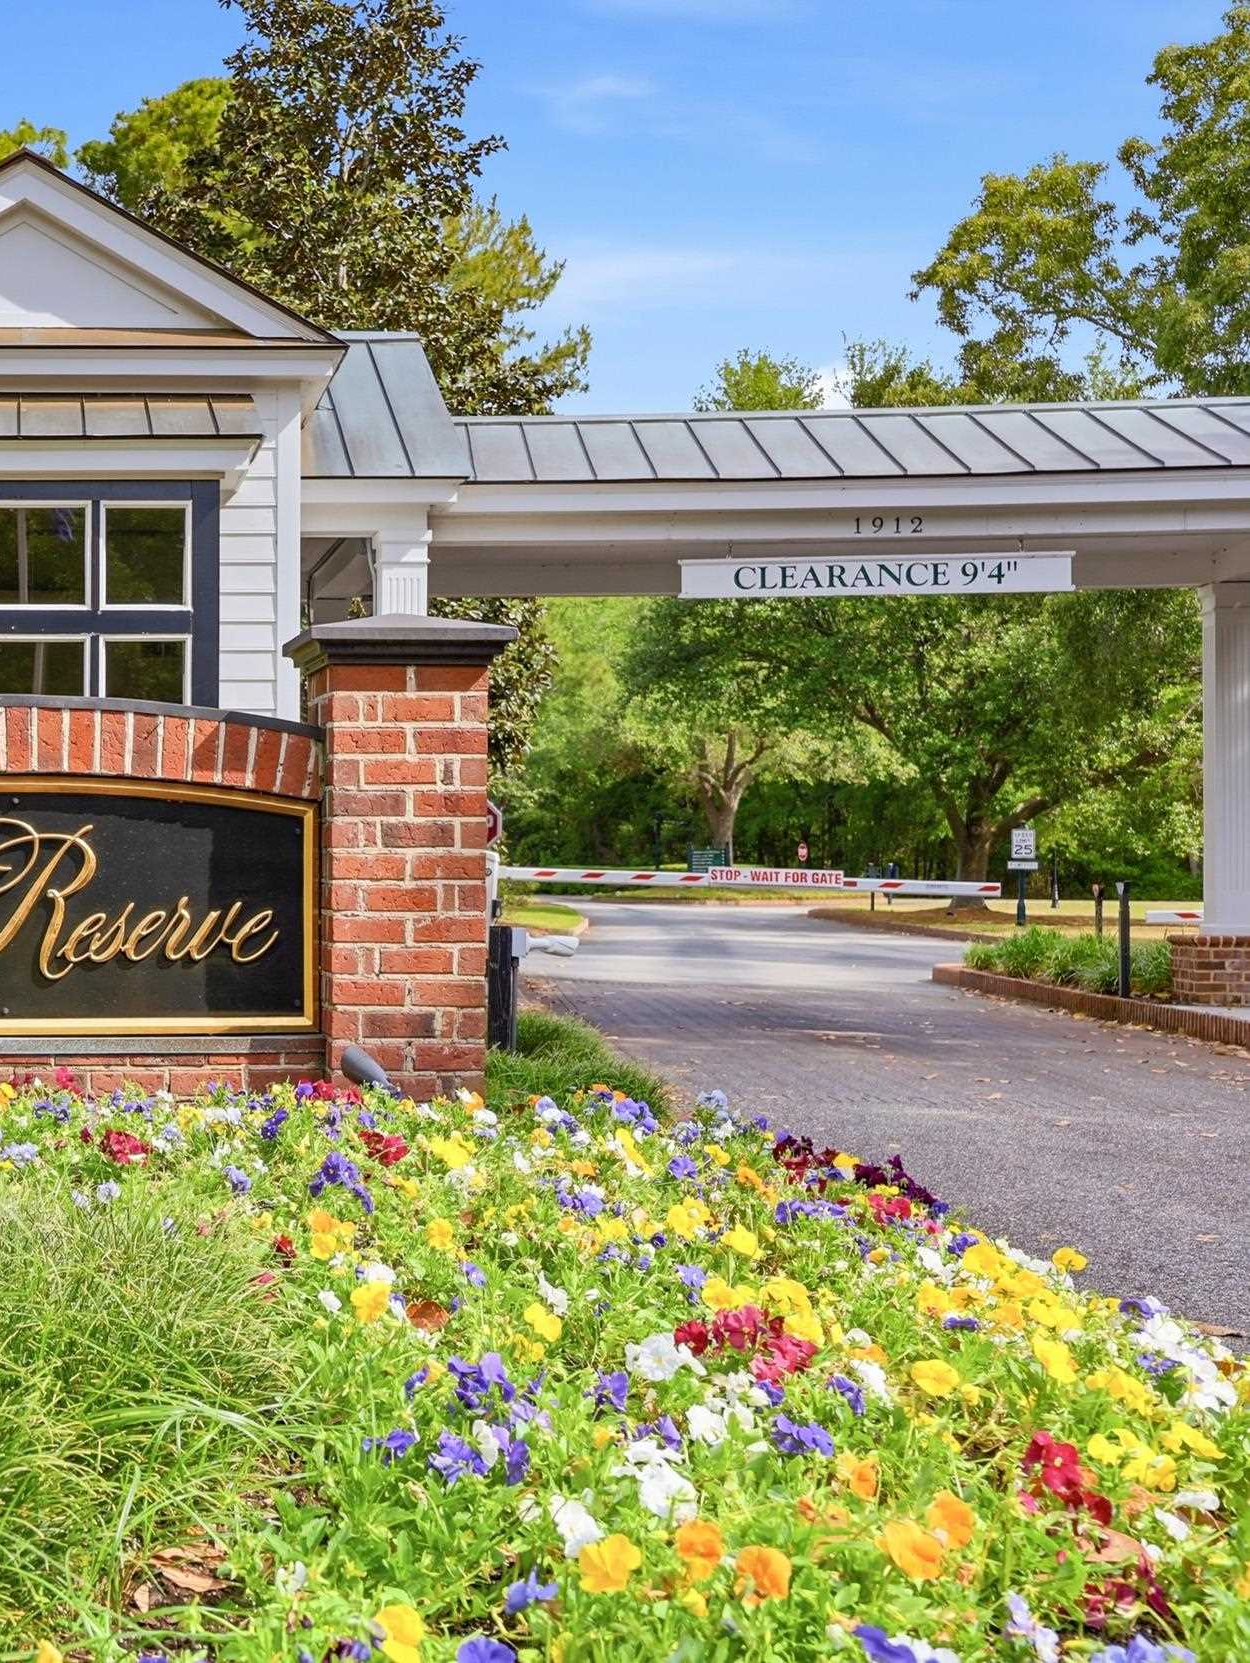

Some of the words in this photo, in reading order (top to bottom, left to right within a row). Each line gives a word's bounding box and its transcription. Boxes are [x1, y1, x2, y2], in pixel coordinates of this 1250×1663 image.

[853, 515, 924, 535] 1912
[733, 562, 950, 591] CLEARANCE
[960, 560, 1018, 586] 9'4"
[1014, 844, 1033, 855] 25
[710, 869, 741, 881] STOP
[750, 871, 781, 882] WAIT
[784, 872, 808, 883] FOR
[811, 872, 842, 885] GATE
